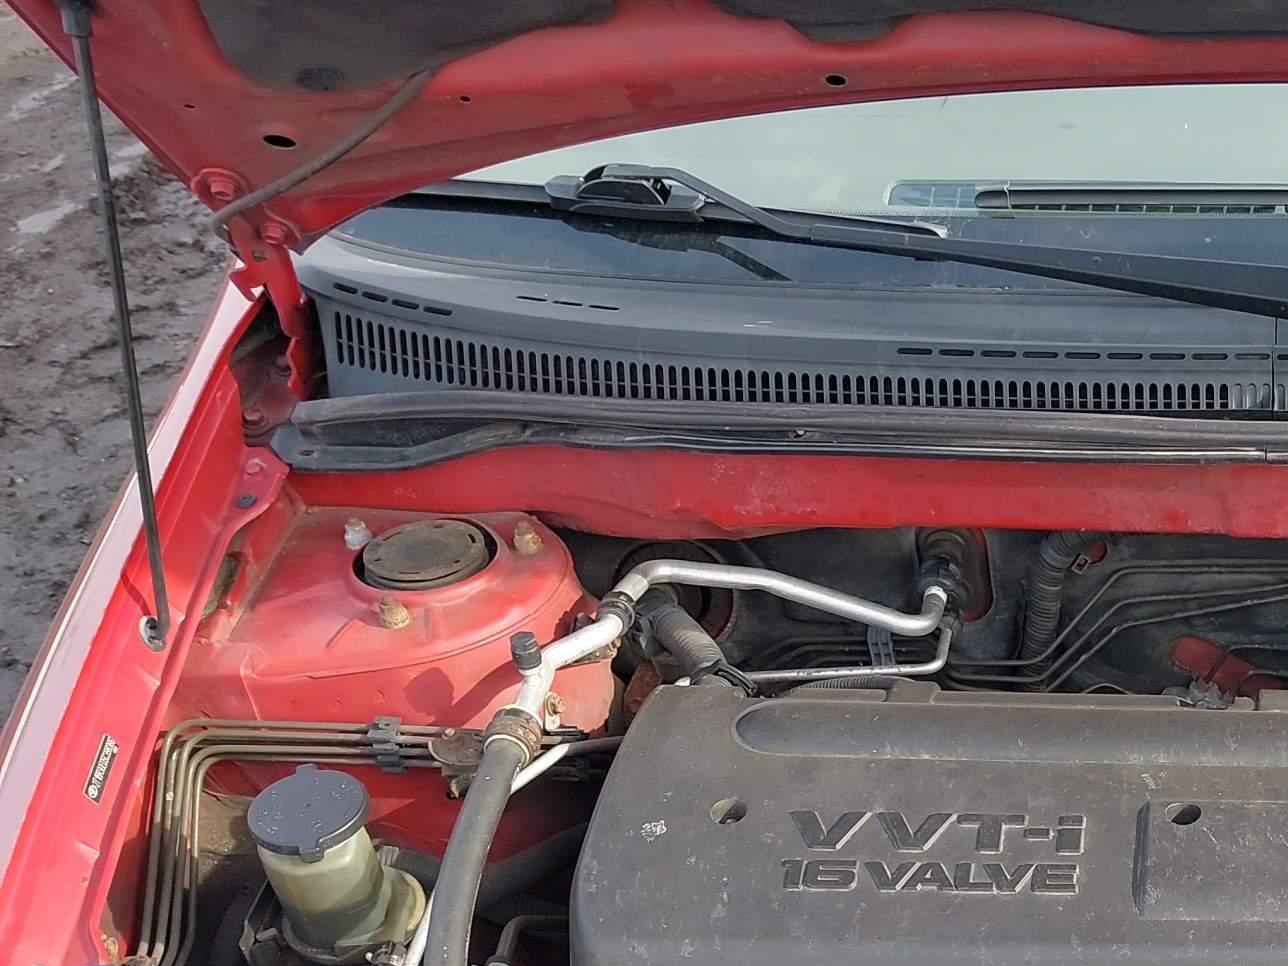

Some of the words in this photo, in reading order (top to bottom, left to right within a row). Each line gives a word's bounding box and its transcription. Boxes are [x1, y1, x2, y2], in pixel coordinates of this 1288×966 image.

[788, 810, 1087, 855] VVT-i
[782, 858, 859, 892] 16
[864, 860, 1080, 895] VALVE
